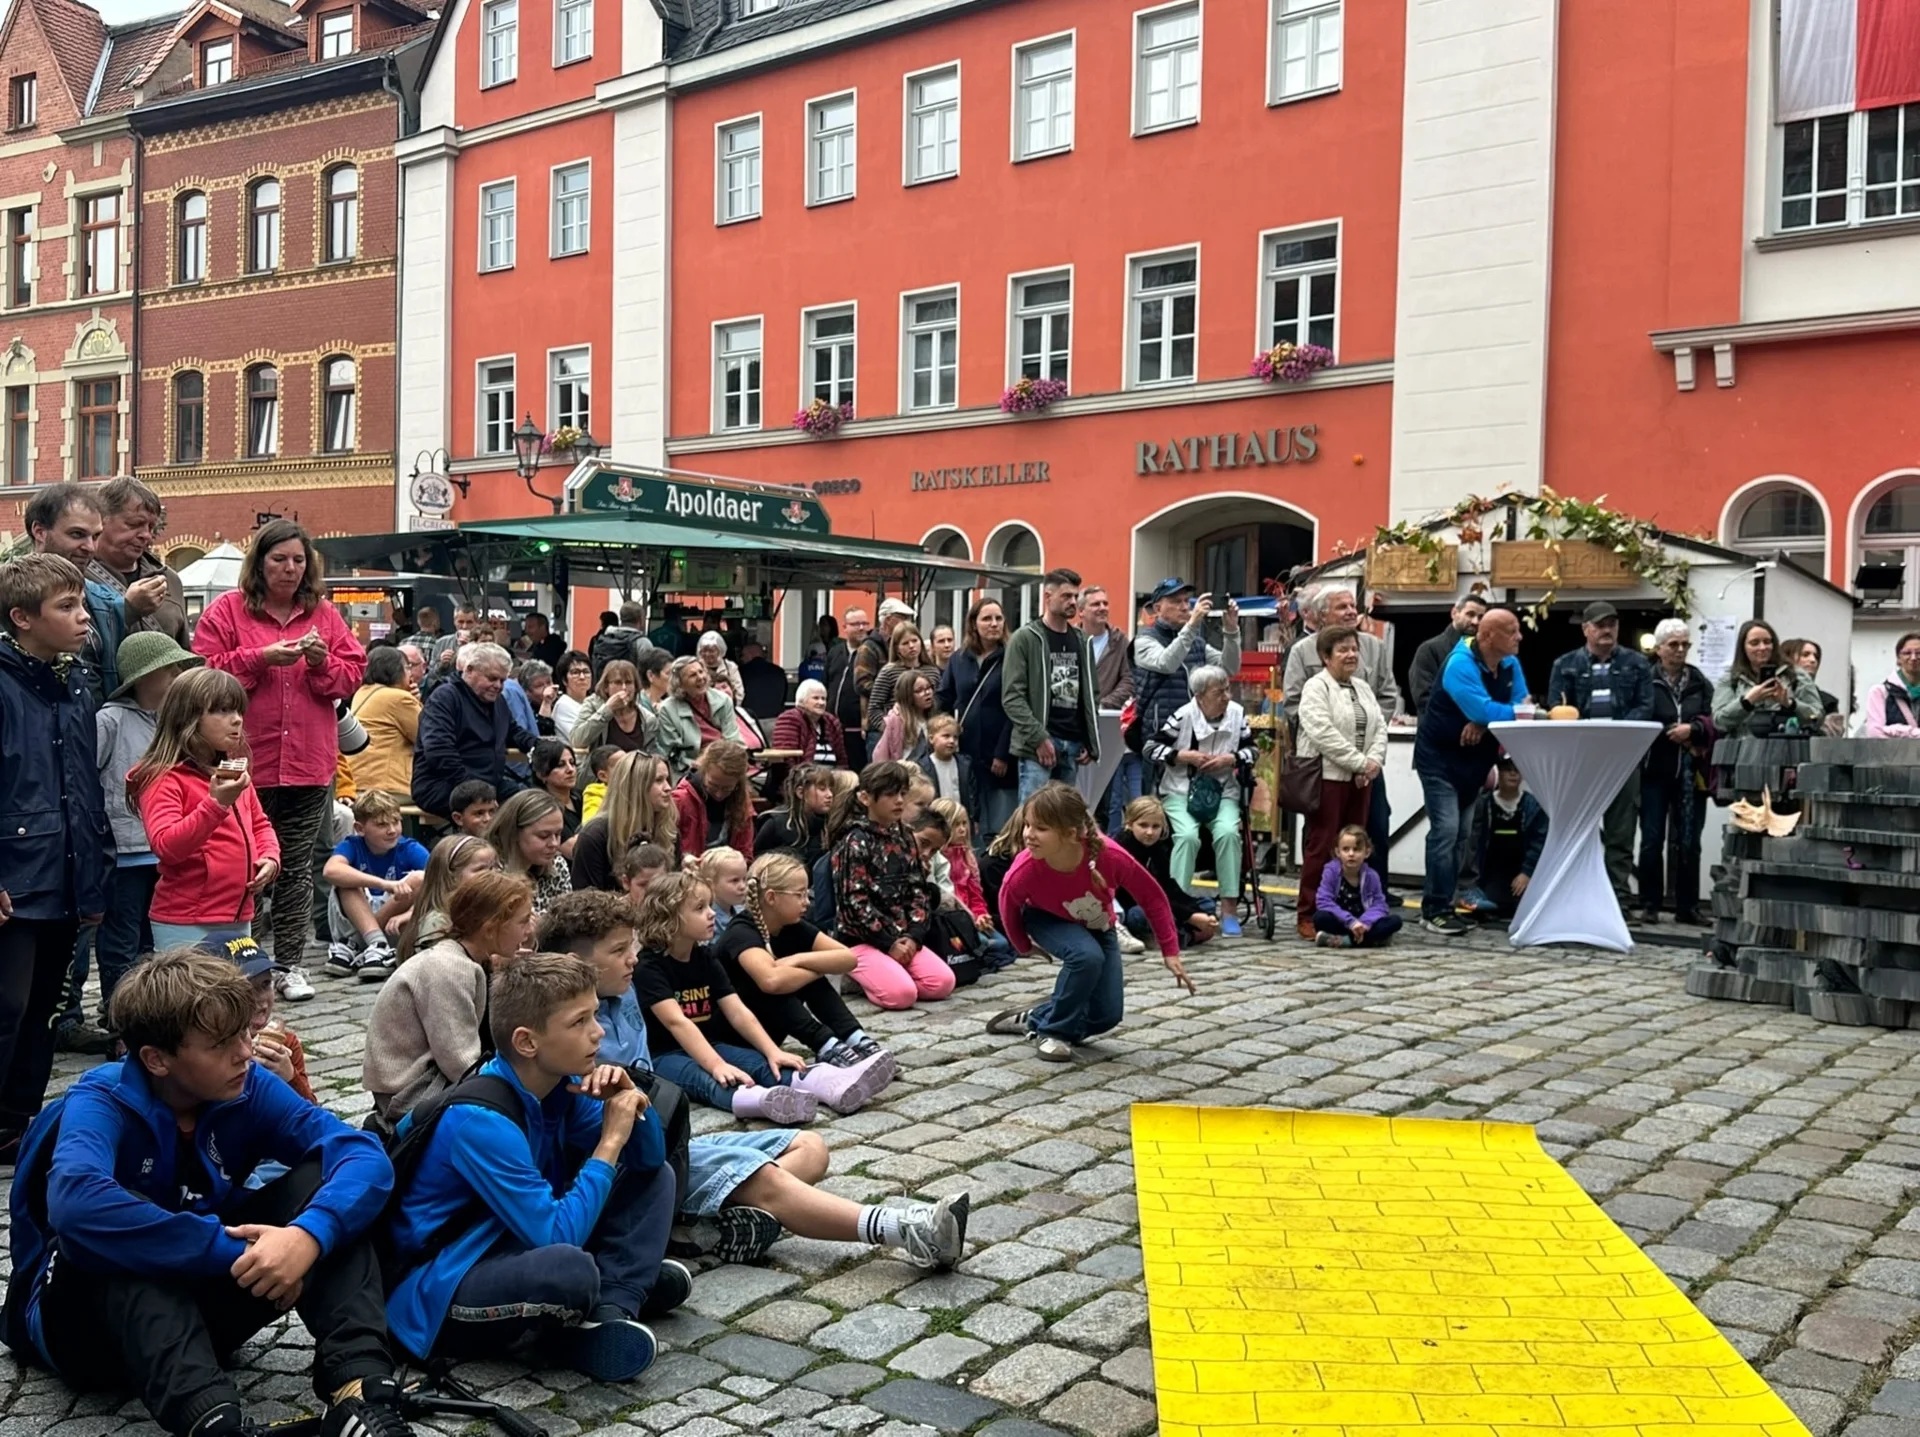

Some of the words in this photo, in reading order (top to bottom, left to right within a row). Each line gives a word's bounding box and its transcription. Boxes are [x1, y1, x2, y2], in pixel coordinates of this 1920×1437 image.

[1135, 424, 1319, 476] RATHAUS
[910, 460, 1050, 492] RATSKELLER
[665, 484, 764, 523] Apoldaer
